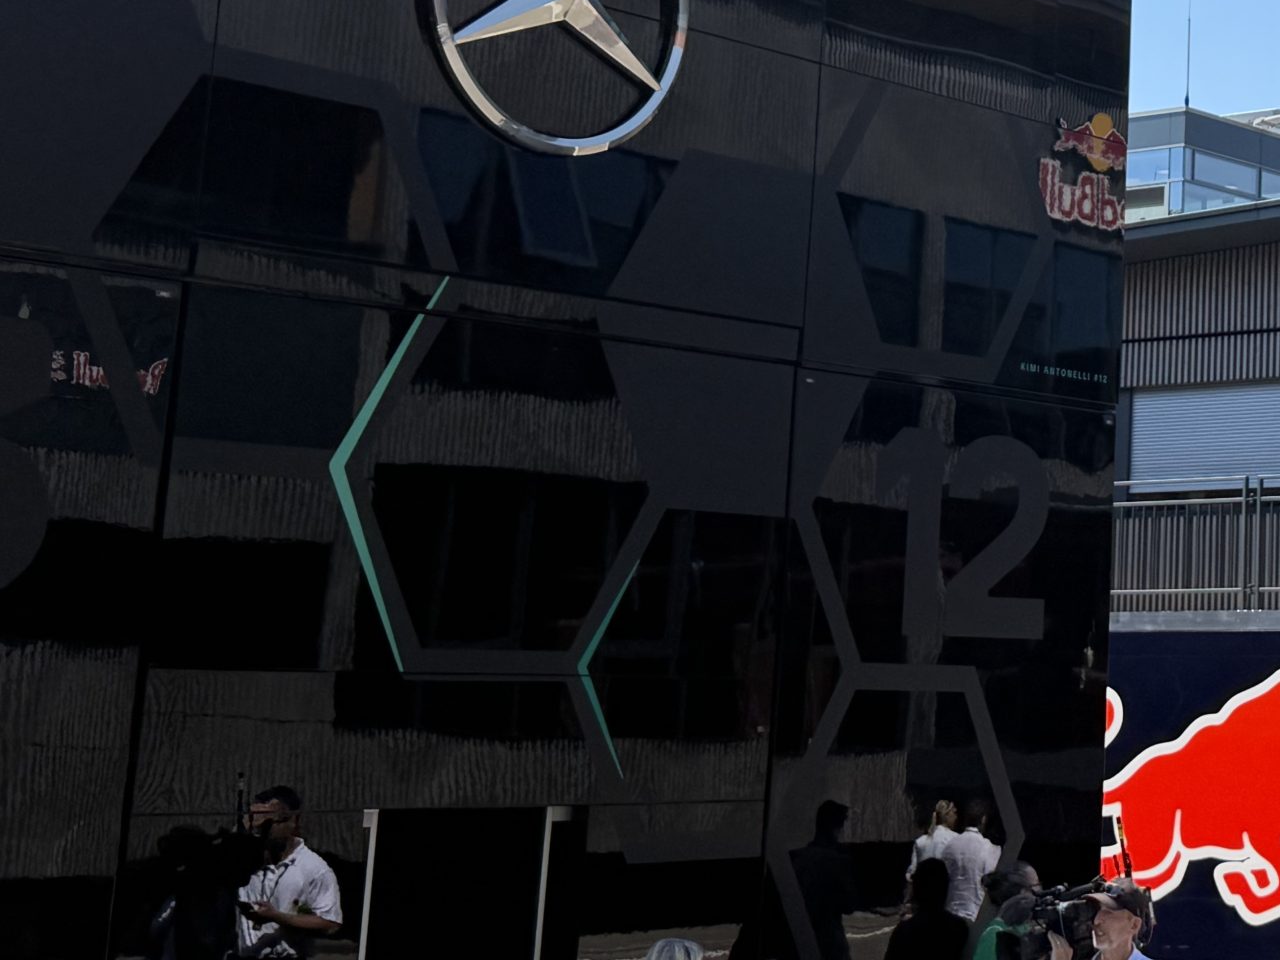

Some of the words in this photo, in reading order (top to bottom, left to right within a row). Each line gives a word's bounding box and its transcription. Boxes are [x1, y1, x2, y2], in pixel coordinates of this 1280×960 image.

[1020, 362, 1040, 373] KIMI
[1043, 366, 1091, 381] ANTONELLI
[876, 427, 1050, 640] 12
